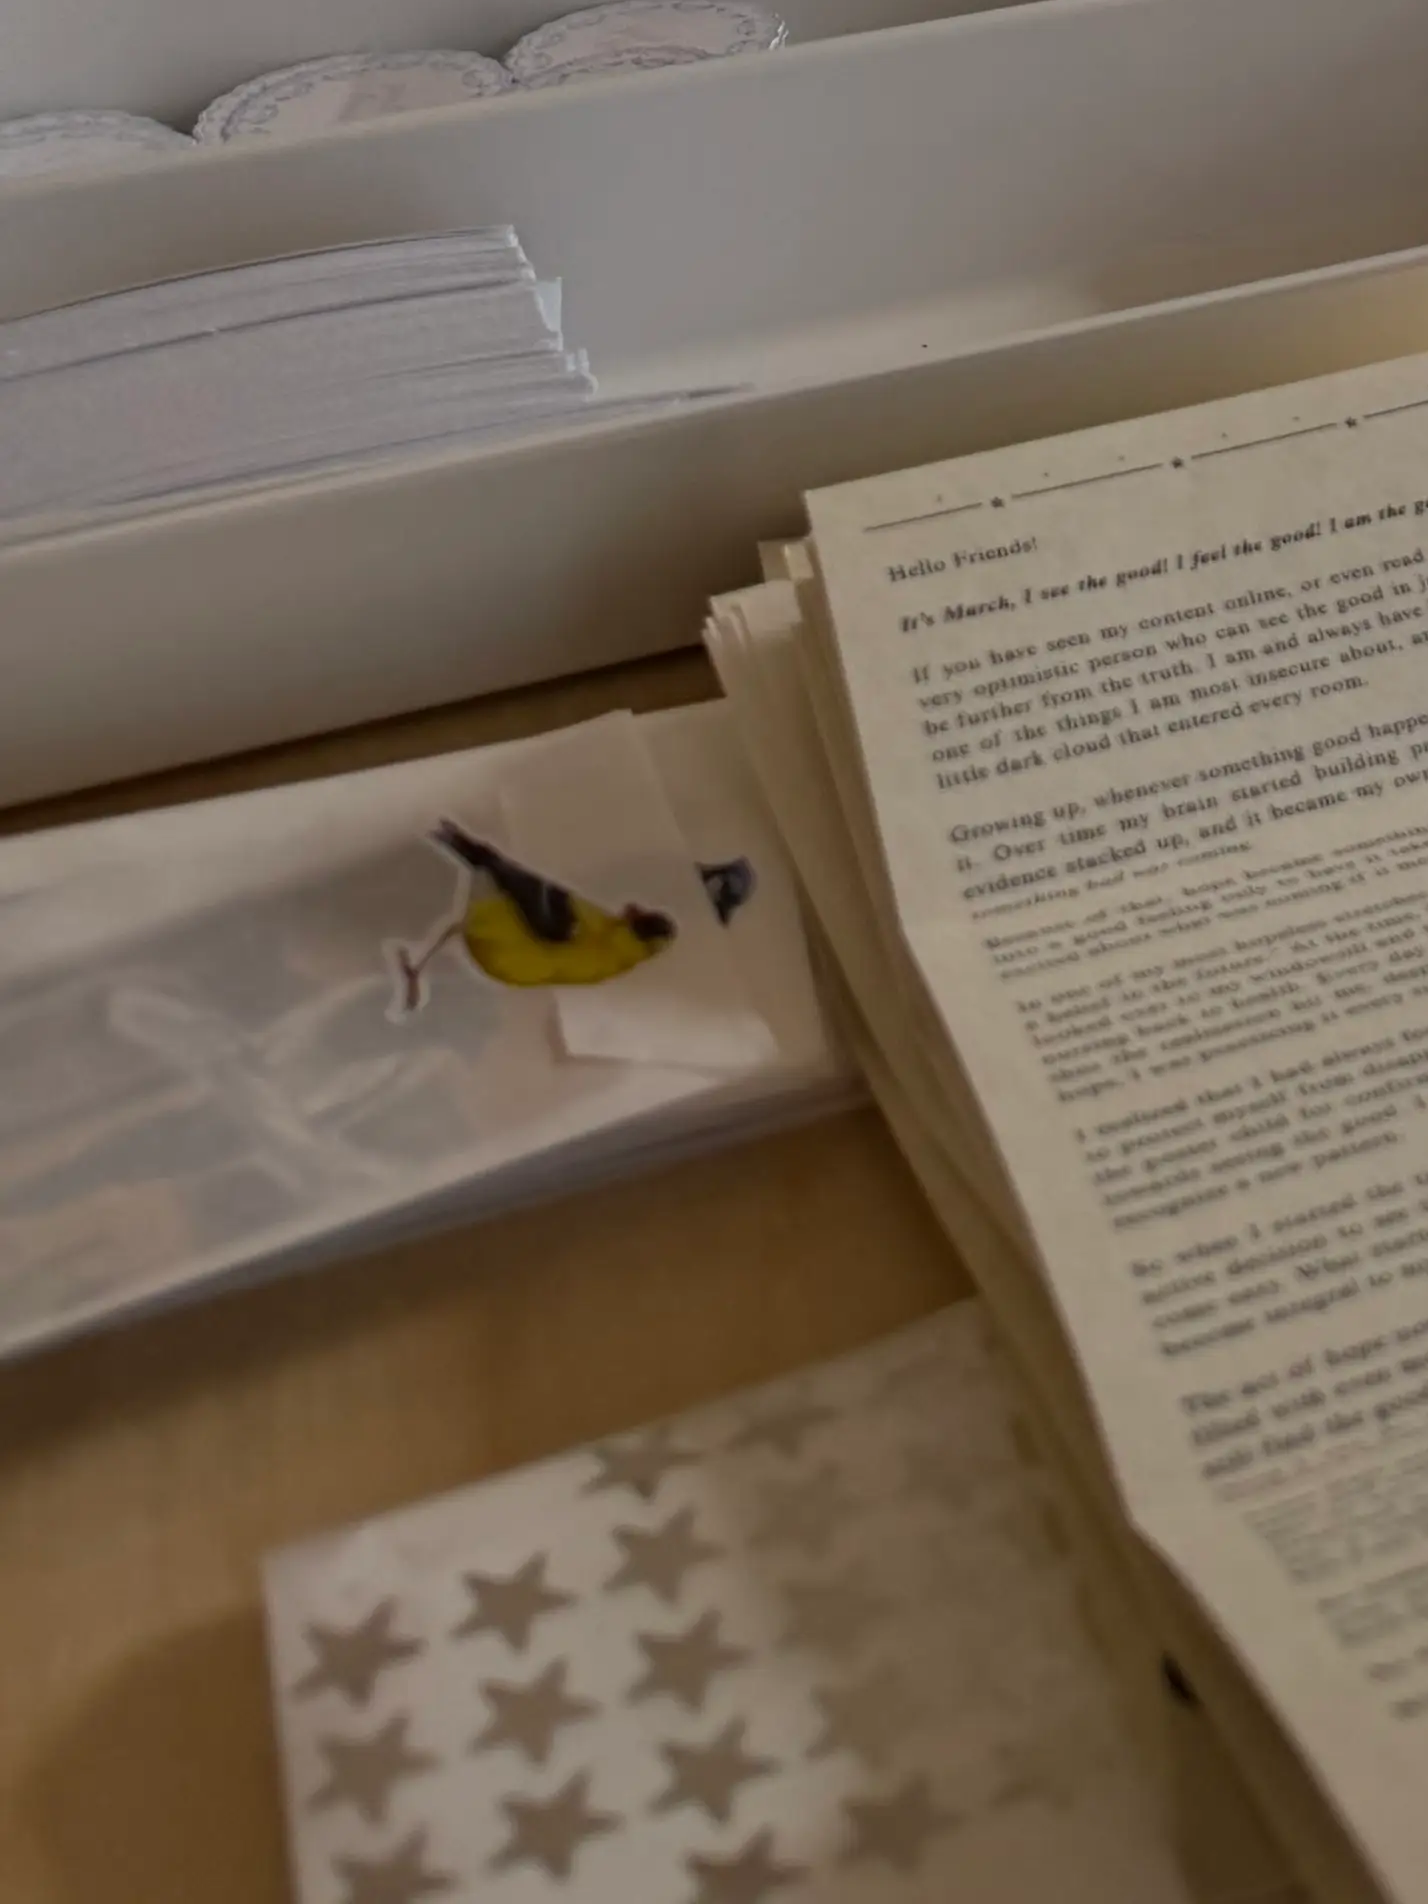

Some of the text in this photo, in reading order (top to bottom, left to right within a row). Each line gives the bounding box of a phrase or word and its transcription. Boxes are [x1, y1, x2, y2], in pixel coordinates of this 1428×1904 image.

[1188, 542, 1228, 572] feel
[1231, 537, 1263, 558] the
[1267, 519, 1323, 553] good!
[1341, 512, 1373, 531] am
[1376, 502, 1407, 522] the
[1221, 585, 1294, 612] online,
[1298, 575, 1322, 593] or
[1326, 563, 1376, 586] even
[1377, 546, 1427, 574] read
[1162, 631, 1208, 653] who
[1213, 621, 1252, 641] can
[1255, 611, 1291, 631] see
[1293, 601, 1329, 622] the
[1334, 583, 1385, 616] good
[1389, 581, 1413, 597] in
[1223, 647, 1258, 666] am
[1258, 630, 1301, 657] and
[1305, 617, 1374, 645] always
[1375, 604, 1424, 628] have
[1186, 676, 1241, 704] most
[1243, 654, 1331, 688] insecure
[1337, 637, 1405, 665] about,
[1164, 699, 1246, 735] entered
[1245, 688, 1303, 715] every
[1307, 674, 1370, 700] room.
[1196, 743, 1307, 783] something
[1309, 724, 1363, 759] good
